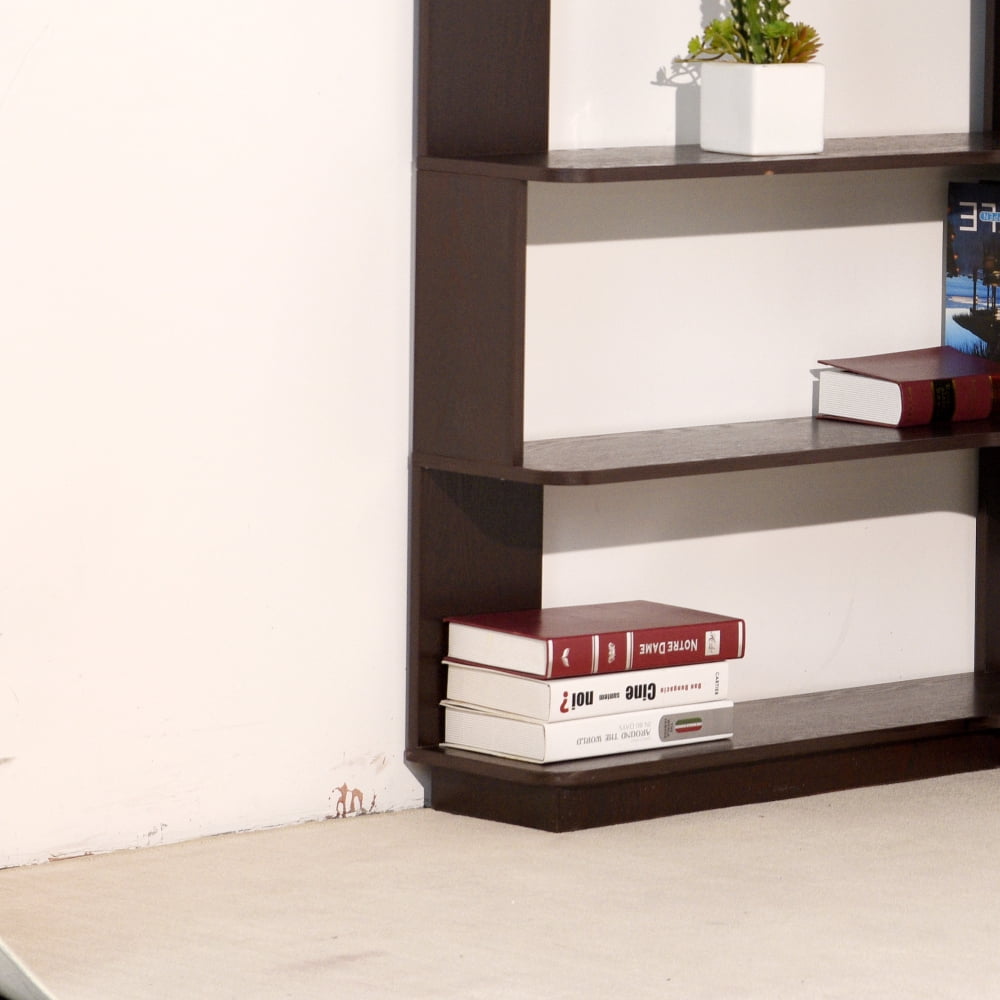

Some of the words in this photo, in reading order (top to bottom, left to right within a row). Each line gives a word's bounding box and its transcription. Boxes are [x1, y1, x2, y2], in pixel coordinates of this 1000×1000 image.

[639, 642, 666, 655] DAME
[667, 638, 698, 653] NOTRE
[625, 682, 657, 702] Cine
[604, 732, 618, 741] THE
[620, 728, 652, 740] AROUND
[576, 736, 602, 746] WORLD
